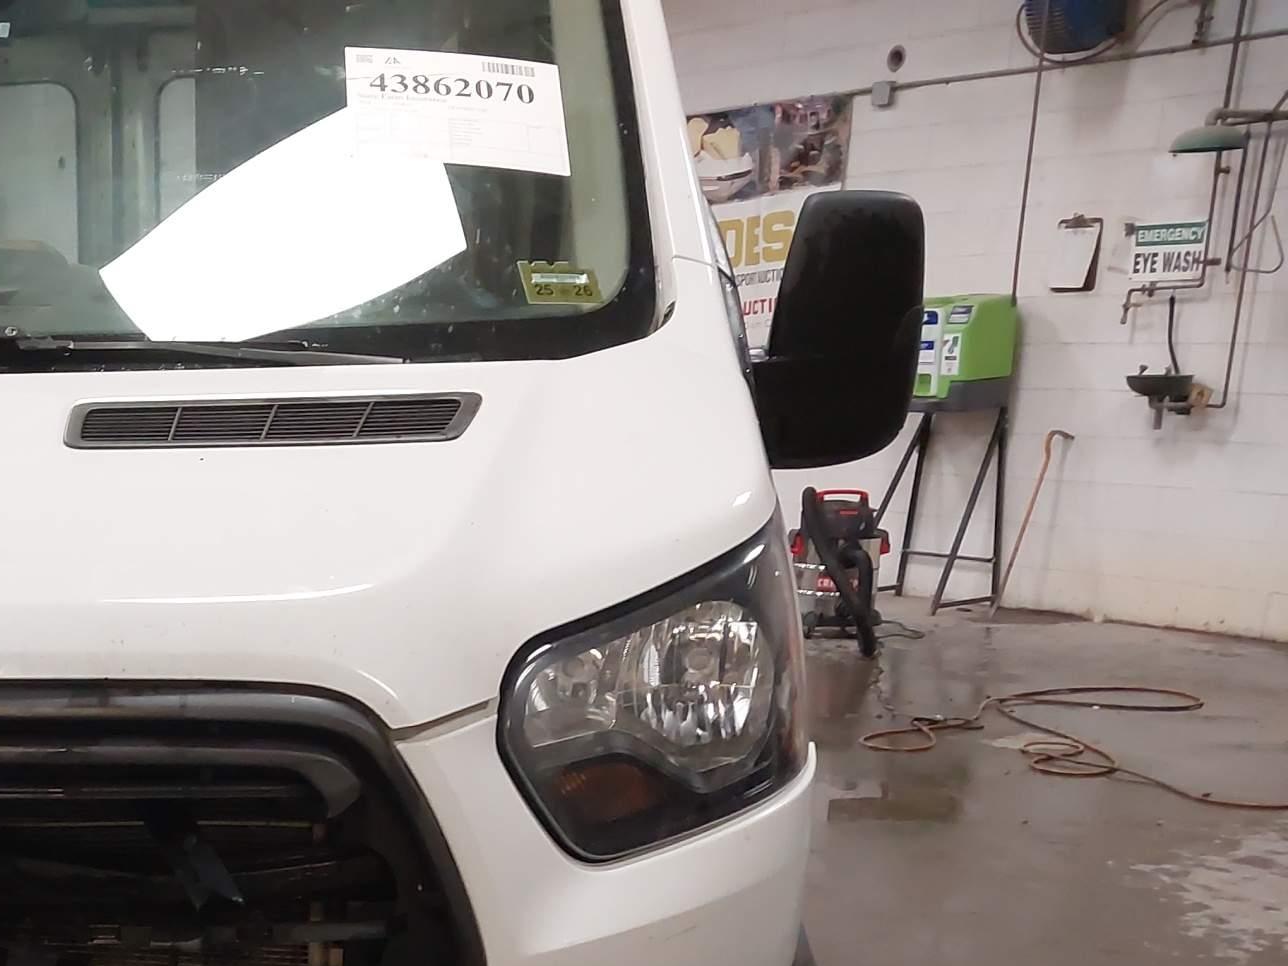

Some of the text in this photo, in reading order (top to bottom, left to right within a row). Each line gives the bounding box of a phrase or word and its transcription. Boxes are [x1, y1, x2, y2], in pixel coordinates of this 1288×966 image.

[369, 73, 535, 104] 43862070
[1137, 226, 1206, 242] EMERGENCY
[1132, 250, 1203, 274] EYE WASH
[535, 284, 593, 297] 25 26
